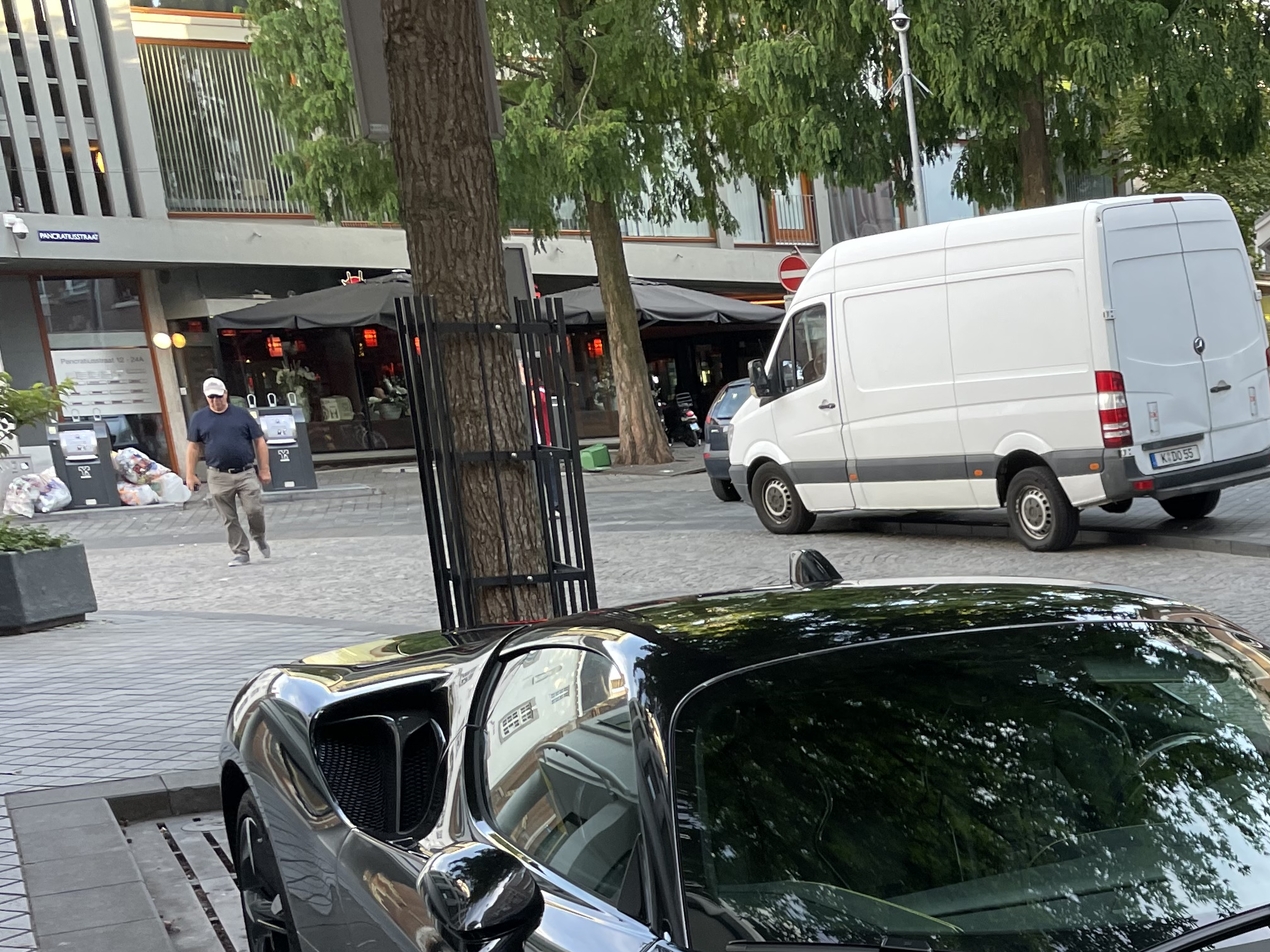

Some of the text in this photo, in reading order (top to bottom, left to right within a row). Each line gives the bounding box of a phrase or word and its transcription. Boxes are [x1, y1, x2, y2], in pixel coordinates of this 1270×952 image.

[40, 232, 99, 241] PANCRATIUSSTRAAT
[60, 357, 115, 365] Pancratiusstraat
[1183, 447, 1194, 460] 55
